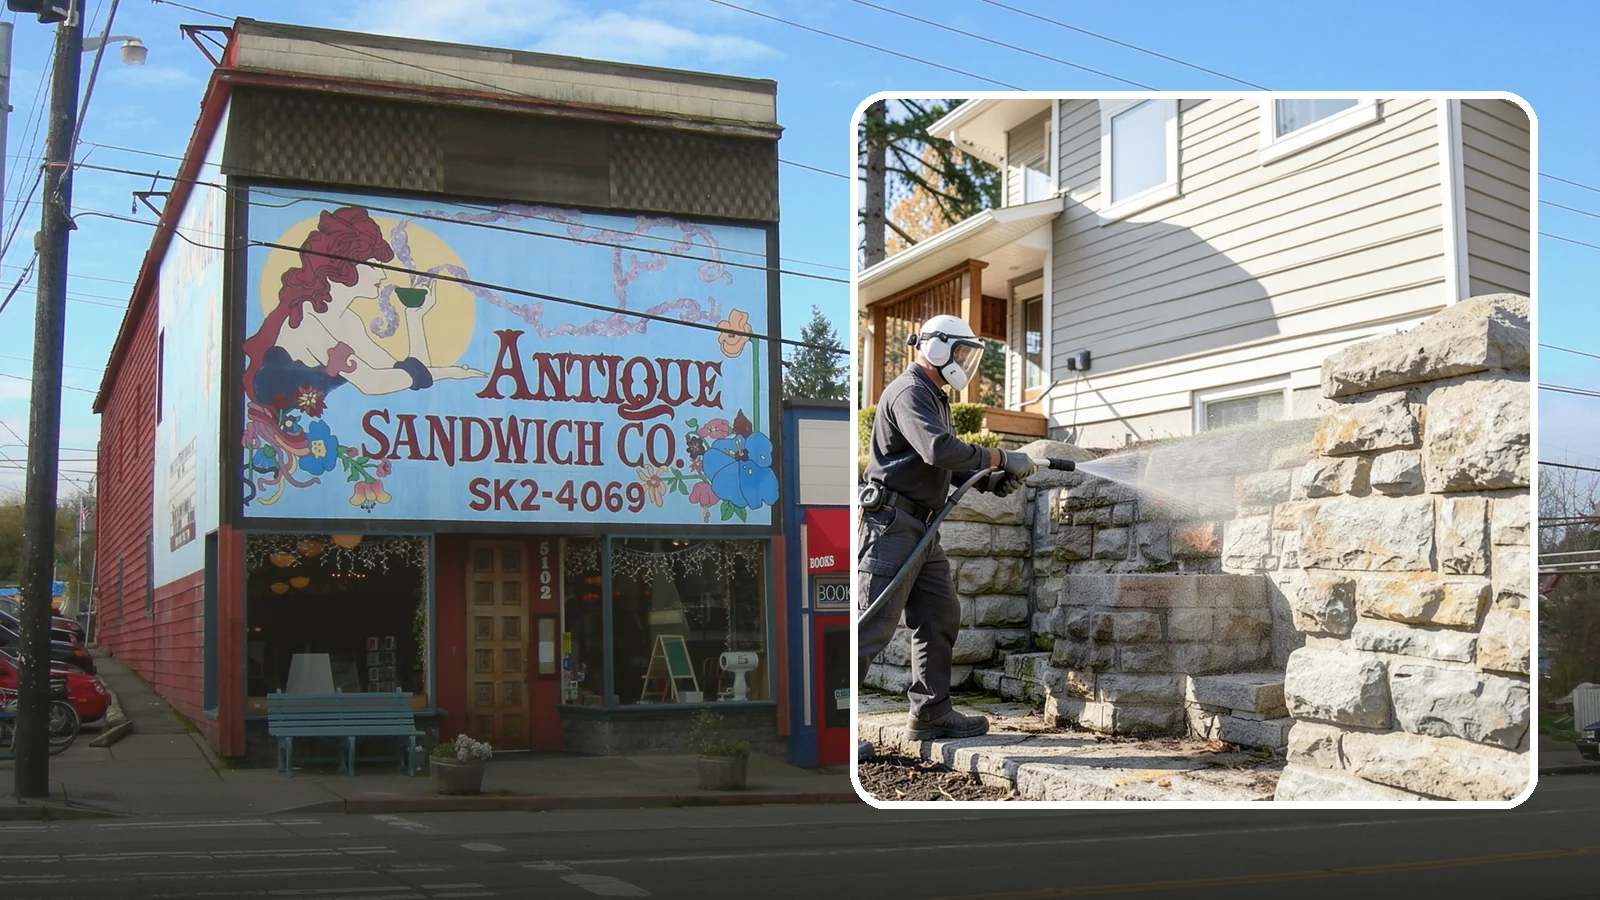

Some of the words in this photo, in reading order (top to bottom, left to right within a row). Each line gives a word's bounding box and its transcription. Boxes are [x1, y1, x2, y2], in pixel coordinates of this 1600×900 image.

[476, 329, 723, 420] ANTIQUE
[361, 408, 604, 467] SANDWICH
[617, 421, 685, 468] CO.
[469, 477, 645, 512] SK2-4069
[540, 542, 551, 599] 5102
[810, 555, 834, 568] BOOKS
